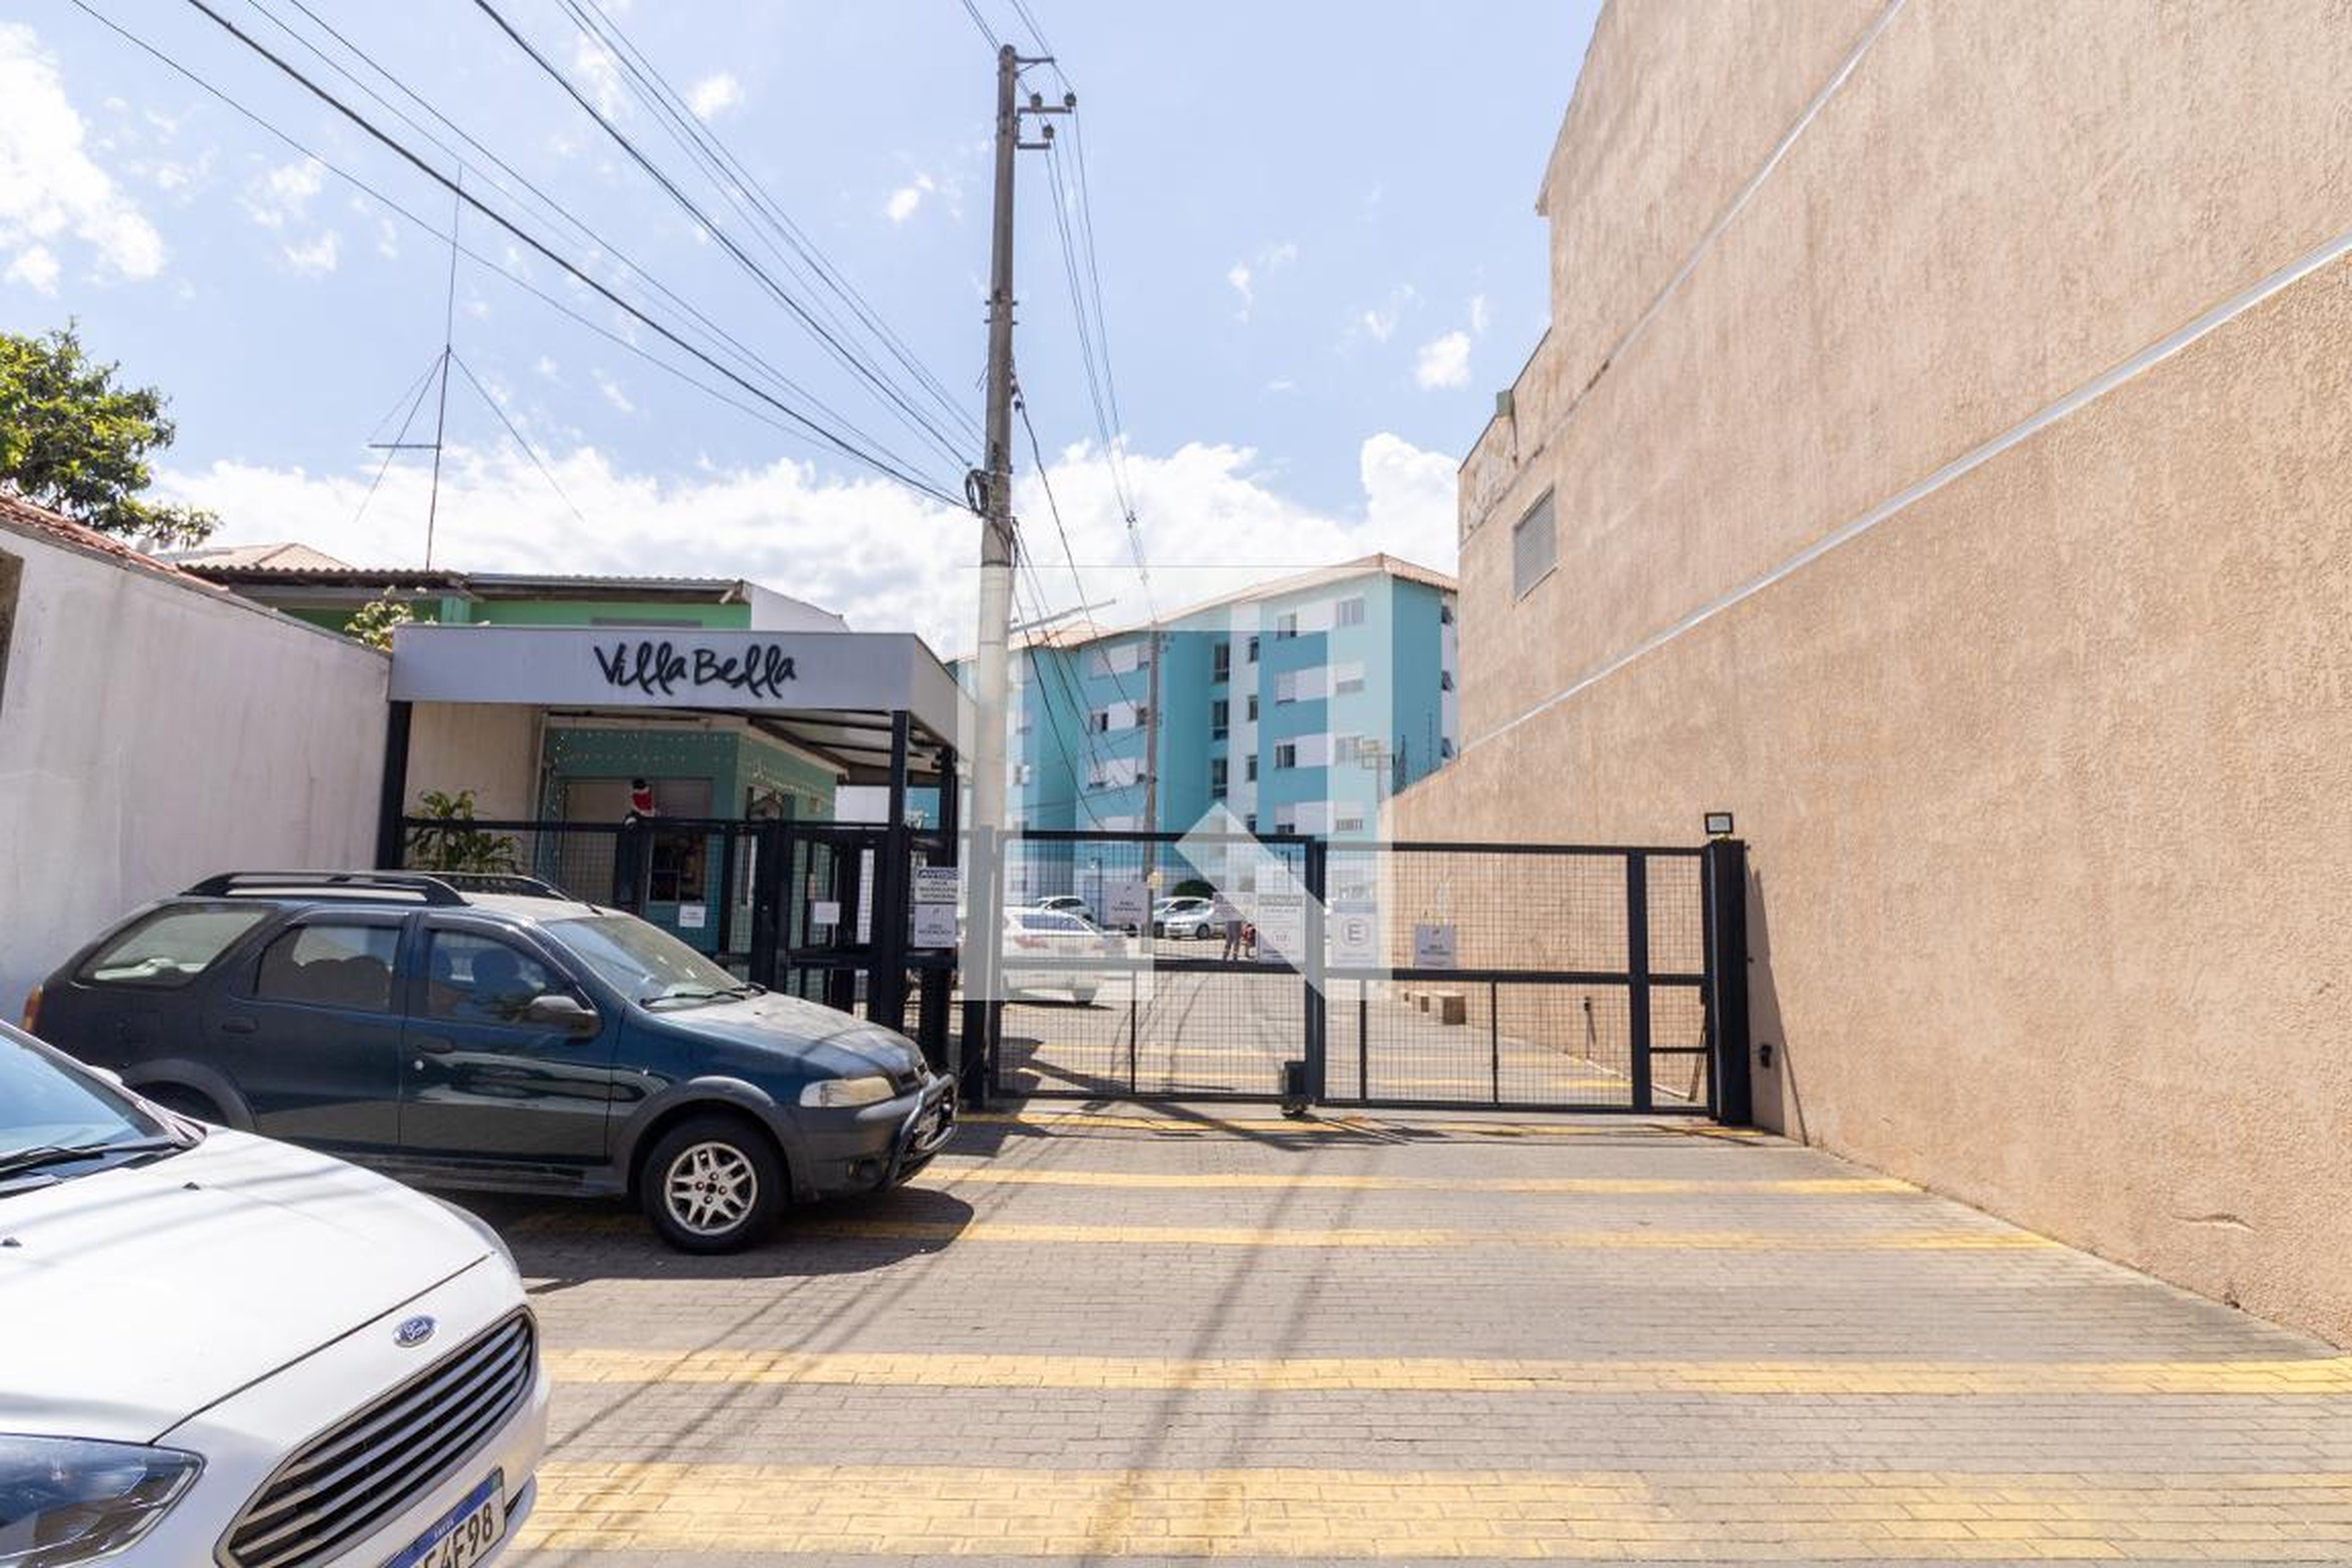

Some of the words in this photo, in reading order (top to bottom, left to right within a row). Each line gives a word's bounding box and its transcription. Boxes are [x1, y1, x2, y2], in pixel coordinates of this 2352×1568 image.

[594, 641, 687, 696] Villa
[693, 644, 797, 699] Bella
[1348, 924, 1363, 941] E
